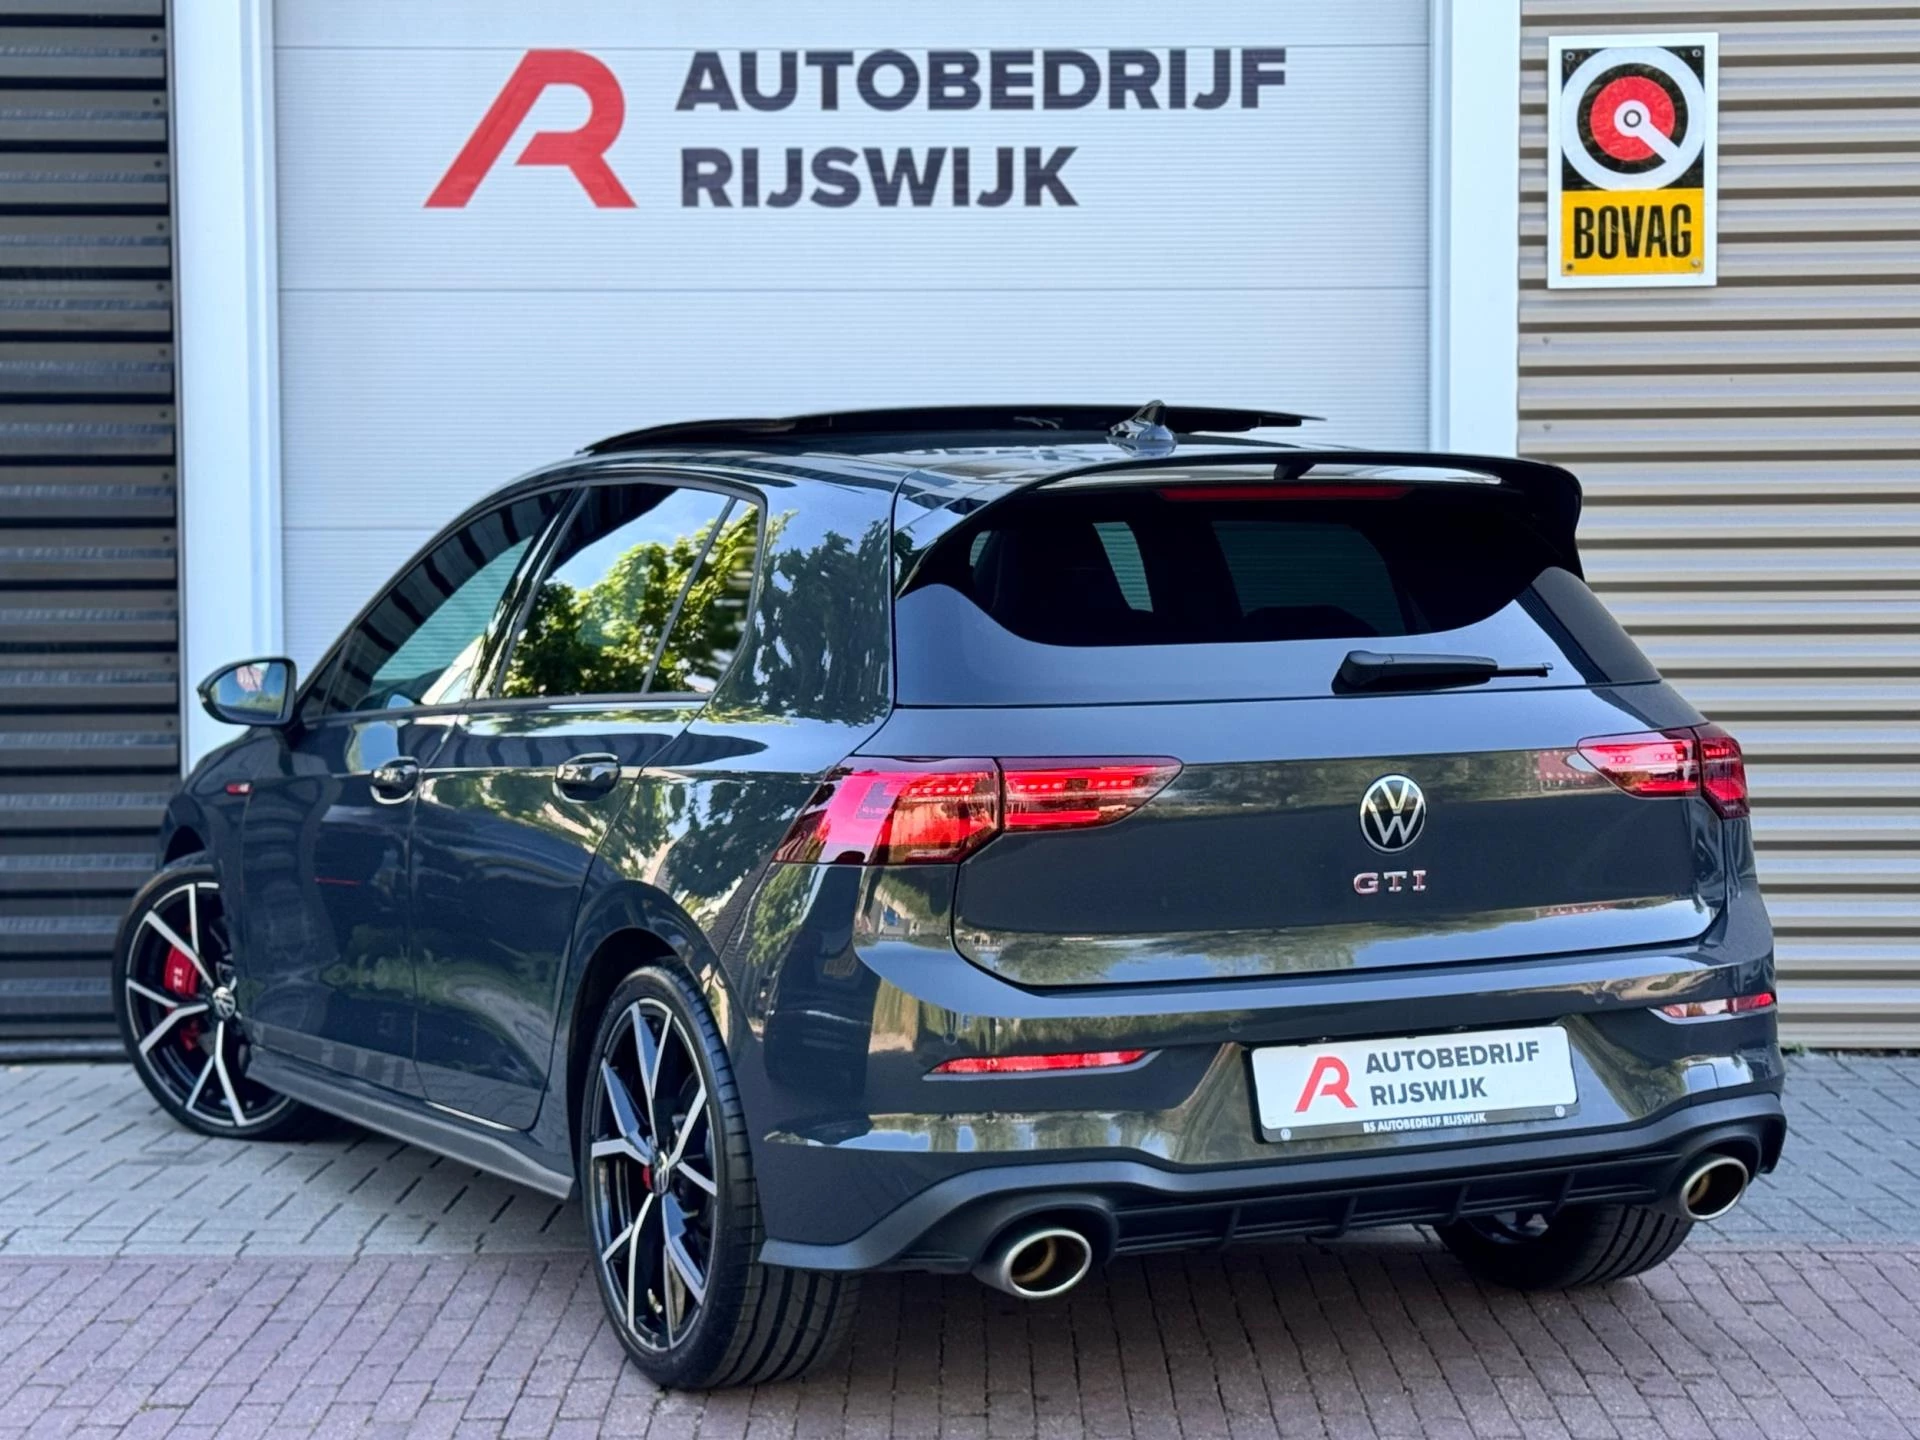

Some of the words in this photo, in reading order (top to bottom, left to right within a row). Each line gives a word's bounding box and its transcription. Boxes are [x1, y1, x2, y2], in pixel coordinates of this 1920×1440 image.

[676, 48, 1287, 112] AUTOBEDRIJF
[681, 146, 1079, 208] RIJSWIJK
[1574, 204, 1692, 260] BOVAG
[1353, 869, 1428, 895] GTI
[1366, 1041, 1540, 1074] AUTOBEDRIJF
[1370, 1076, 1488, 1107] RIJSWIJK
[1362, 1121, 1377, 1134] BS
[1377, 1115, 1442, 1132] AUTOBEDRIJF
[1442, 1111, 1488, 1127] RIJSWIJK
